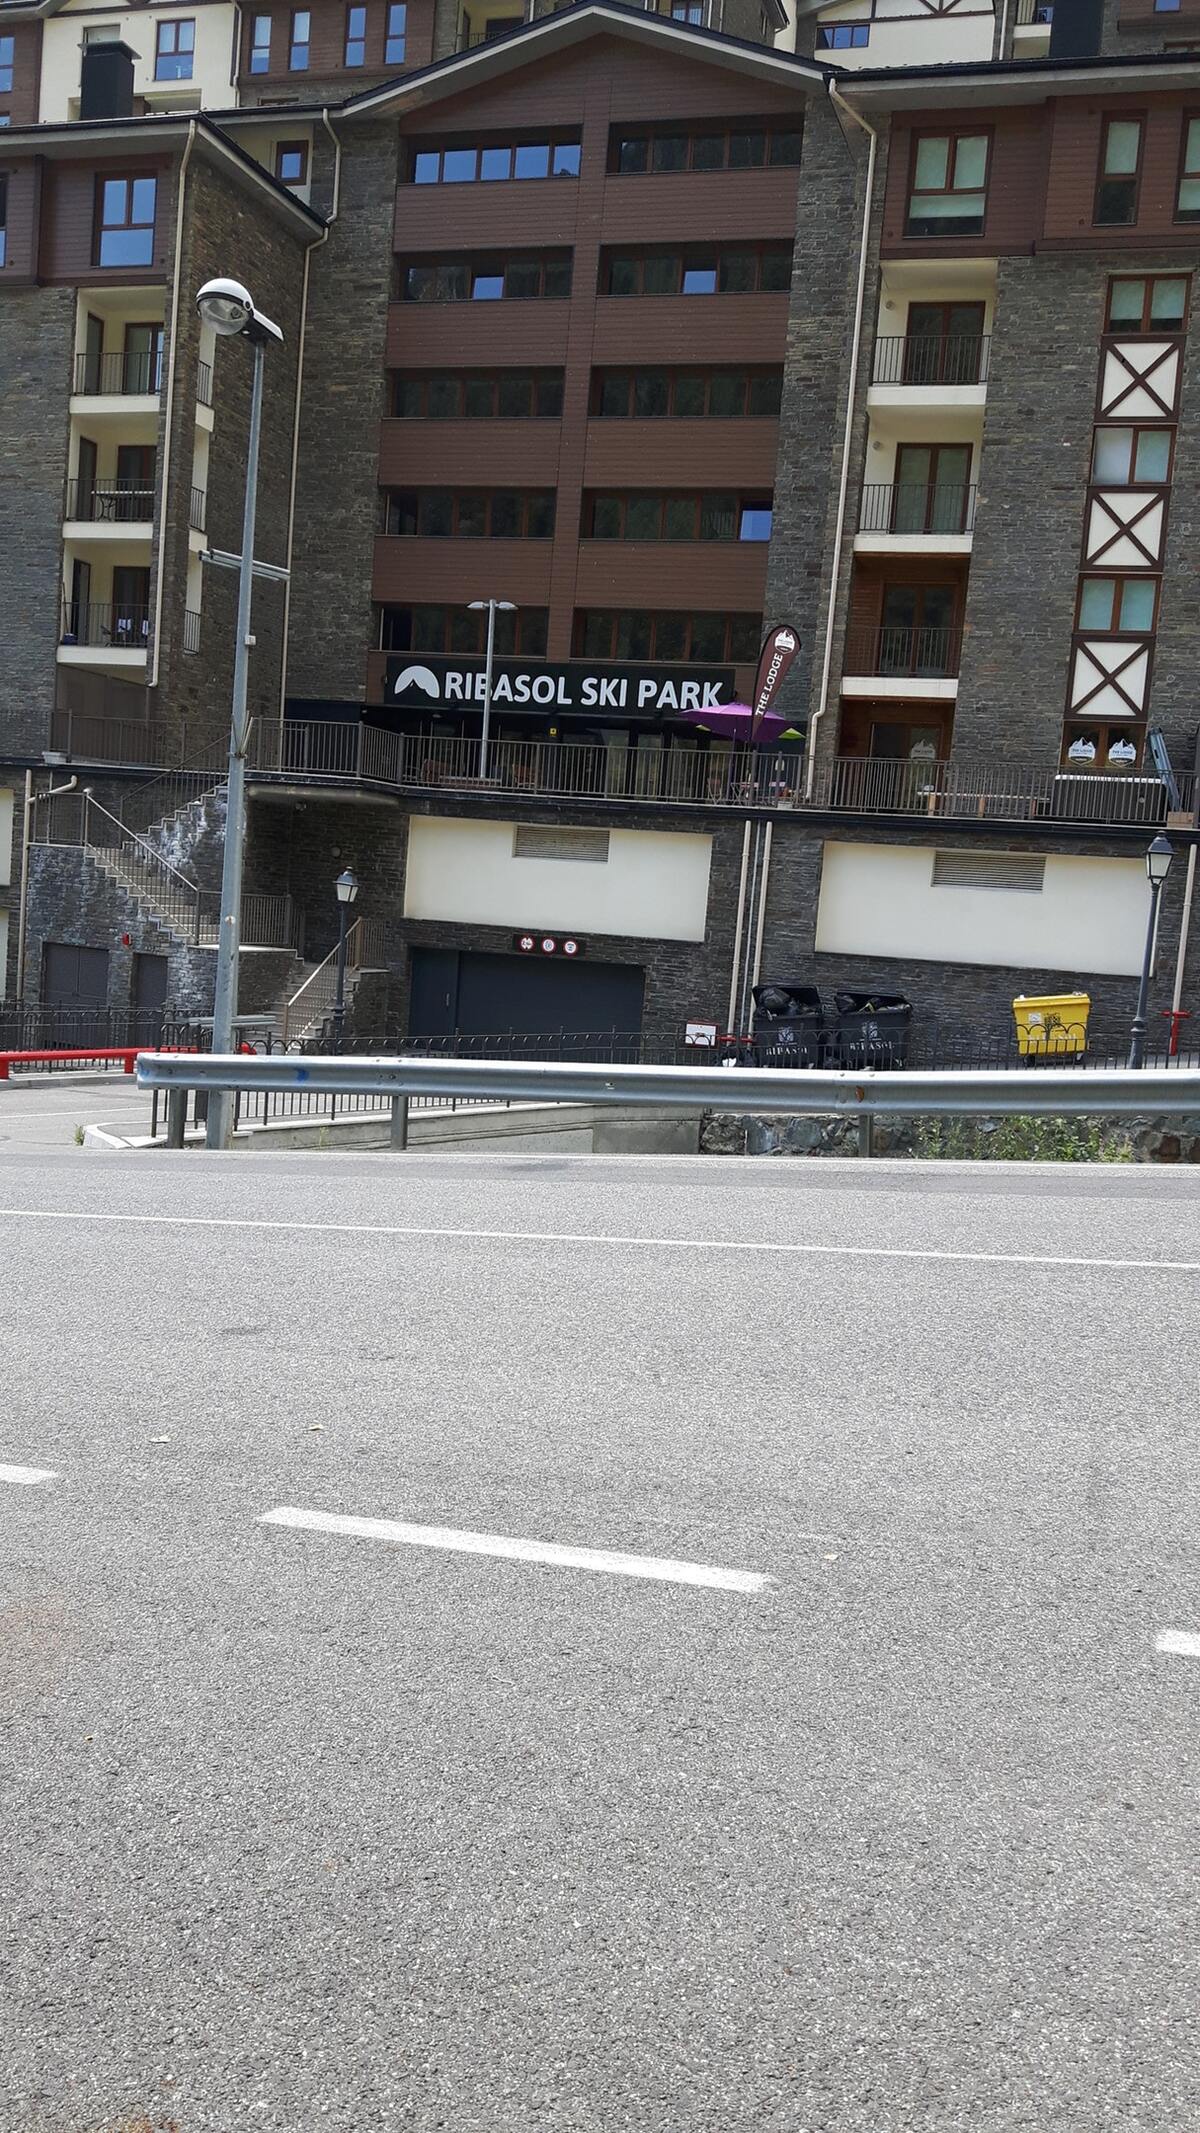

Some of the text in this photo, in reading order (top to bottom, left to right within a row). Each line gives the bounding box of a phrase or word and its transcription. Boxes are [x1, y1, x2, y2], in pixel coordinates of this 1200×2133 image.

[445, 672, 723, 710] RIBASOL SKI PARK
[755, 653, 783, 716] THE LODGE
